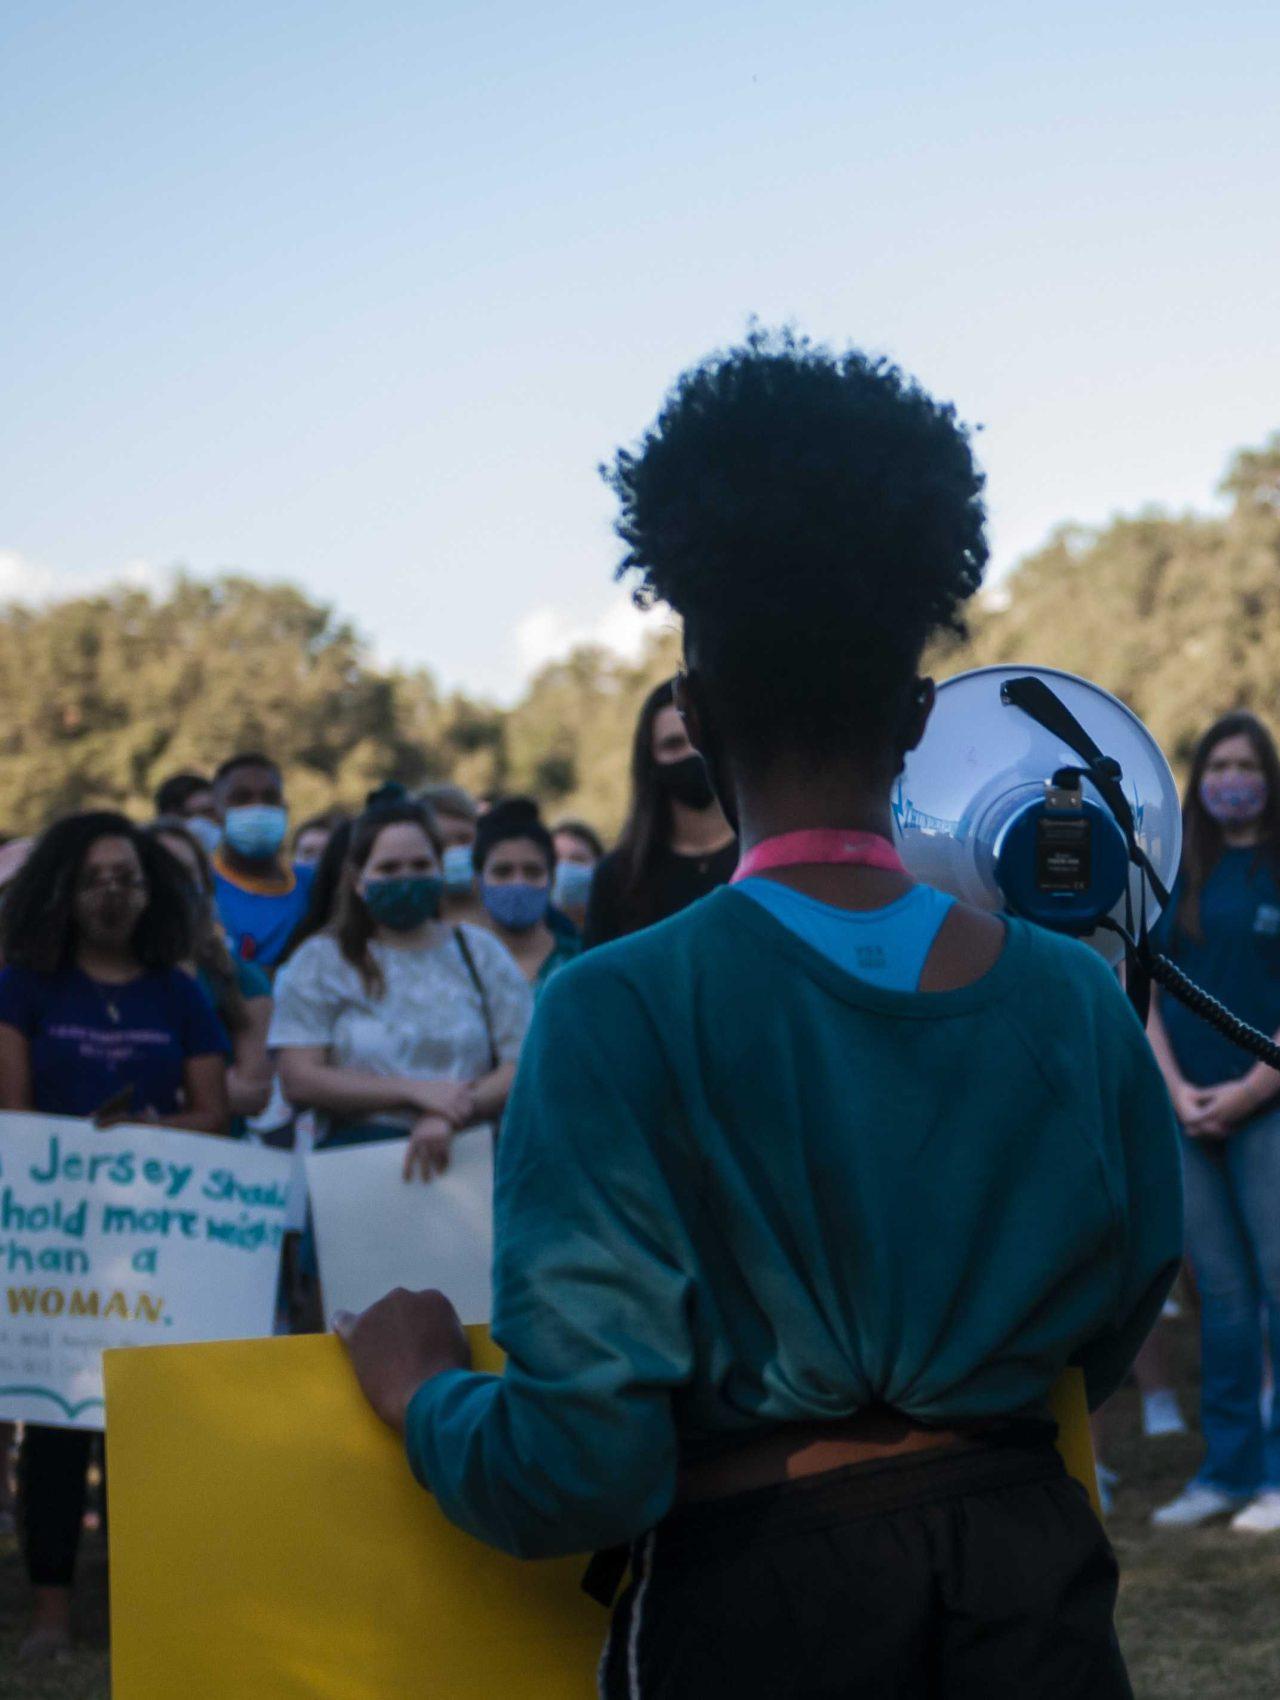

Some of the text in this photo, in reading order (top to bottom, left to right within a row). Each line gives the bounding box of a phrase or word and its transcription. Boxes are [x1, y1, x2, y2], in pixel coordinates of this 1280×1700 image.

[29, 1134, 194, 1198] Jersey
[0, 1185, 88, 1238] hold
[101, 1202, 200, 1238] more
[0, 1239, 159, 1276] han a
[6, 1285, 175, 1327] WOMAN.
